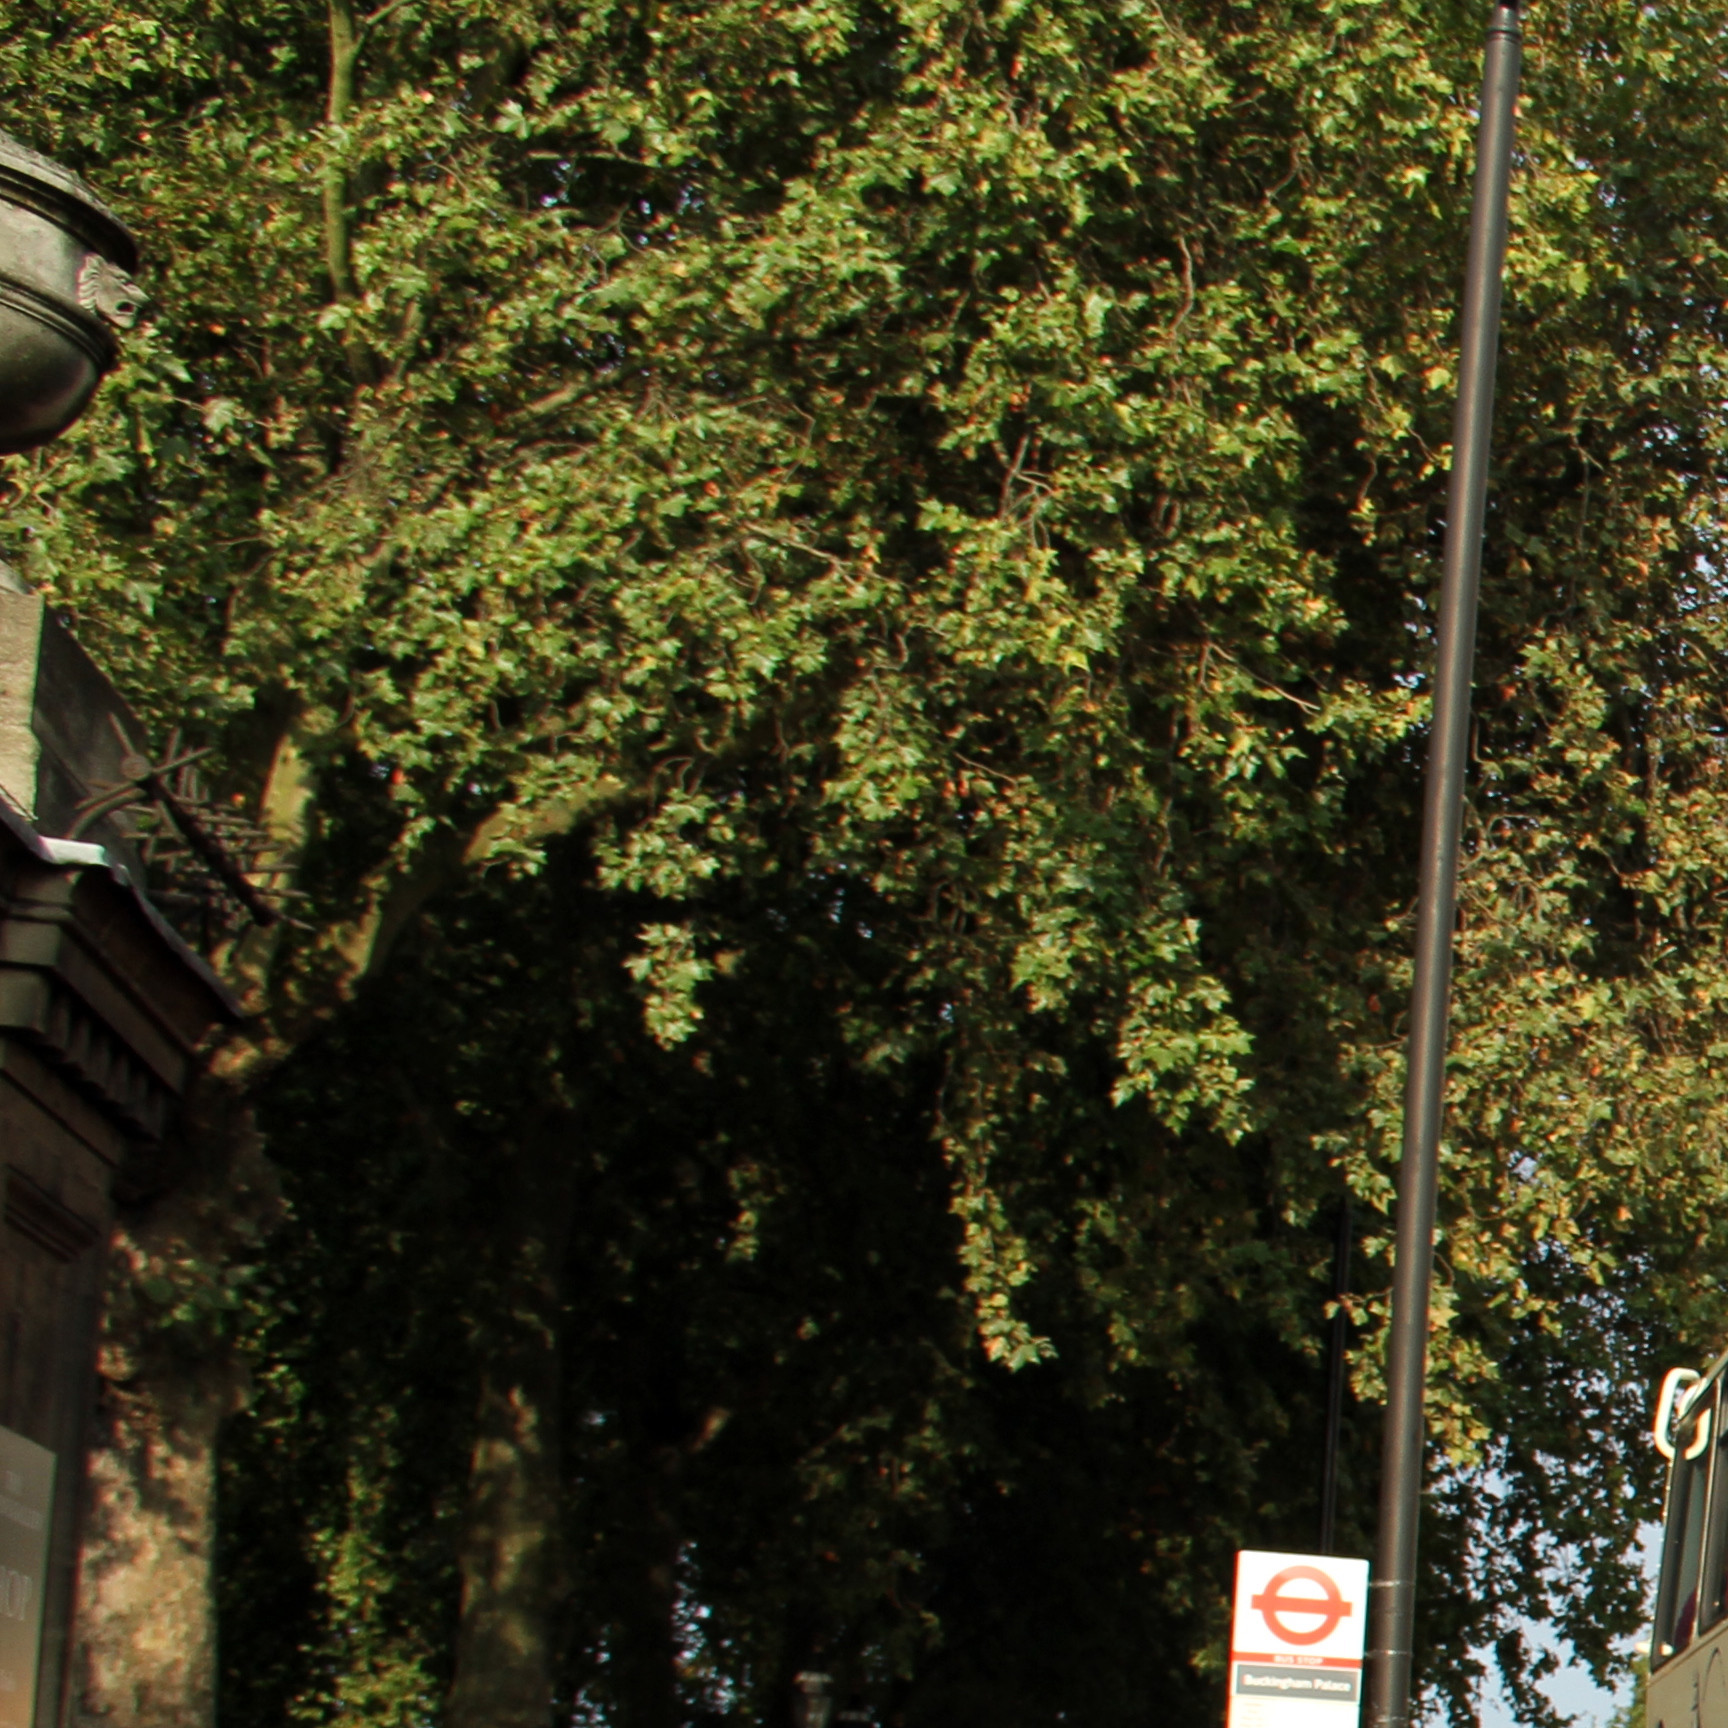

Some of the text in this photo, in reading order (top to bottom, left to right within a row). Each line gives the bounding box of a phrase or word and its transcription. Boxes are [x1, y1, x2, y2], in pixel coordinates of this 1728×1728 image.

[1274, 1654, 1323, 1665] BUS STOP
[1242, 1674, 1352, 1692] Buckingham Palace
